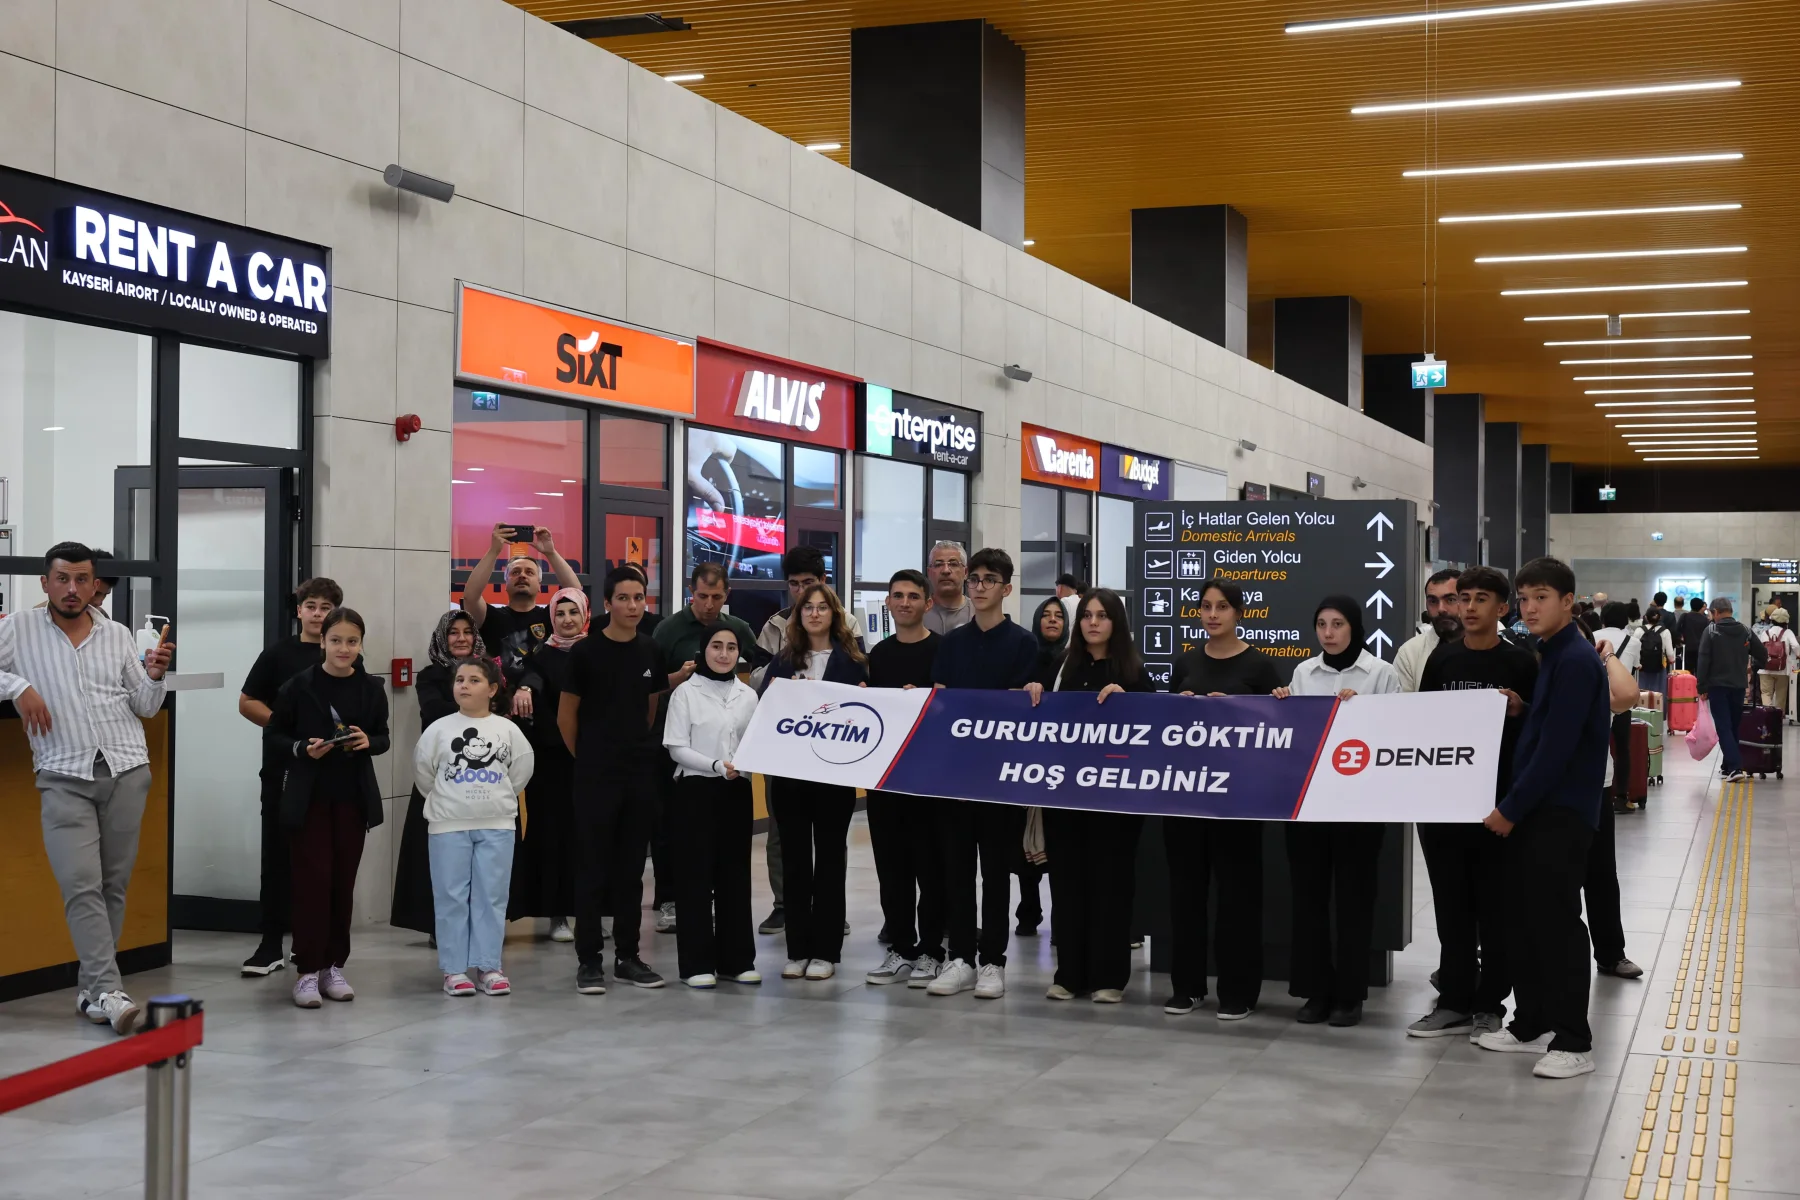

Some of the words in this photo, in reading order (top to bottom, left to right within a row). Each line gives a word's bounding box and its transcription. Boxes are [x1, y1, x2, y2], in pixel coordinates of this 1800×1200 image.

[75, 205, 196, 282] RENT
[206, 241, 238, 293] A
[248, 251, 328, 313] CAR
[62, 269, 113, 293] KAYSERİ
[115, 281, 159, 302] AIRORT
[161, 289, 168, 306] /
[169, 292, 217, 314] LOCALLY
[219, 303, 258, 322] OWNED
[259, 311, 267, 324] &
[268, 313, 318, 334] OPERATED
[873, 404, 977, 453] enterprise
[933, 450, 969, 466] rent-a-car
[1035, 435, 1094, 480] Garenta
[1130, 456, 1160, 491] Budget
[1181, 509, 1195, 529] İç
[1199, 511, 1243, 526] Hatlar
[1246, 511, 1291, 526] Gelen
[1295, 511, 1336, 526] Yolcu
[1181, 529, 1243, 542] Domestic
[1245, 529, 1297, 542] Arrivals
[1213, 549, 1257, 564] Giden
[1262, 550, 1302, 564] Yolcu
[1213, 567, 1288, 581] Departures
[1235, 626, 1300, 644] Danışma
[776, 715, 870, 744] GÖKTİM
[950, 717, 1152, 746] GURURUMUZ
[1160, 720, 1294, 749] GÖKTİM
[1375, 746, 1476, 767] DENER
[998, 761, 1066, 790] HOŞ
[1075, 764, 1231, 793] GELDİNİZ
